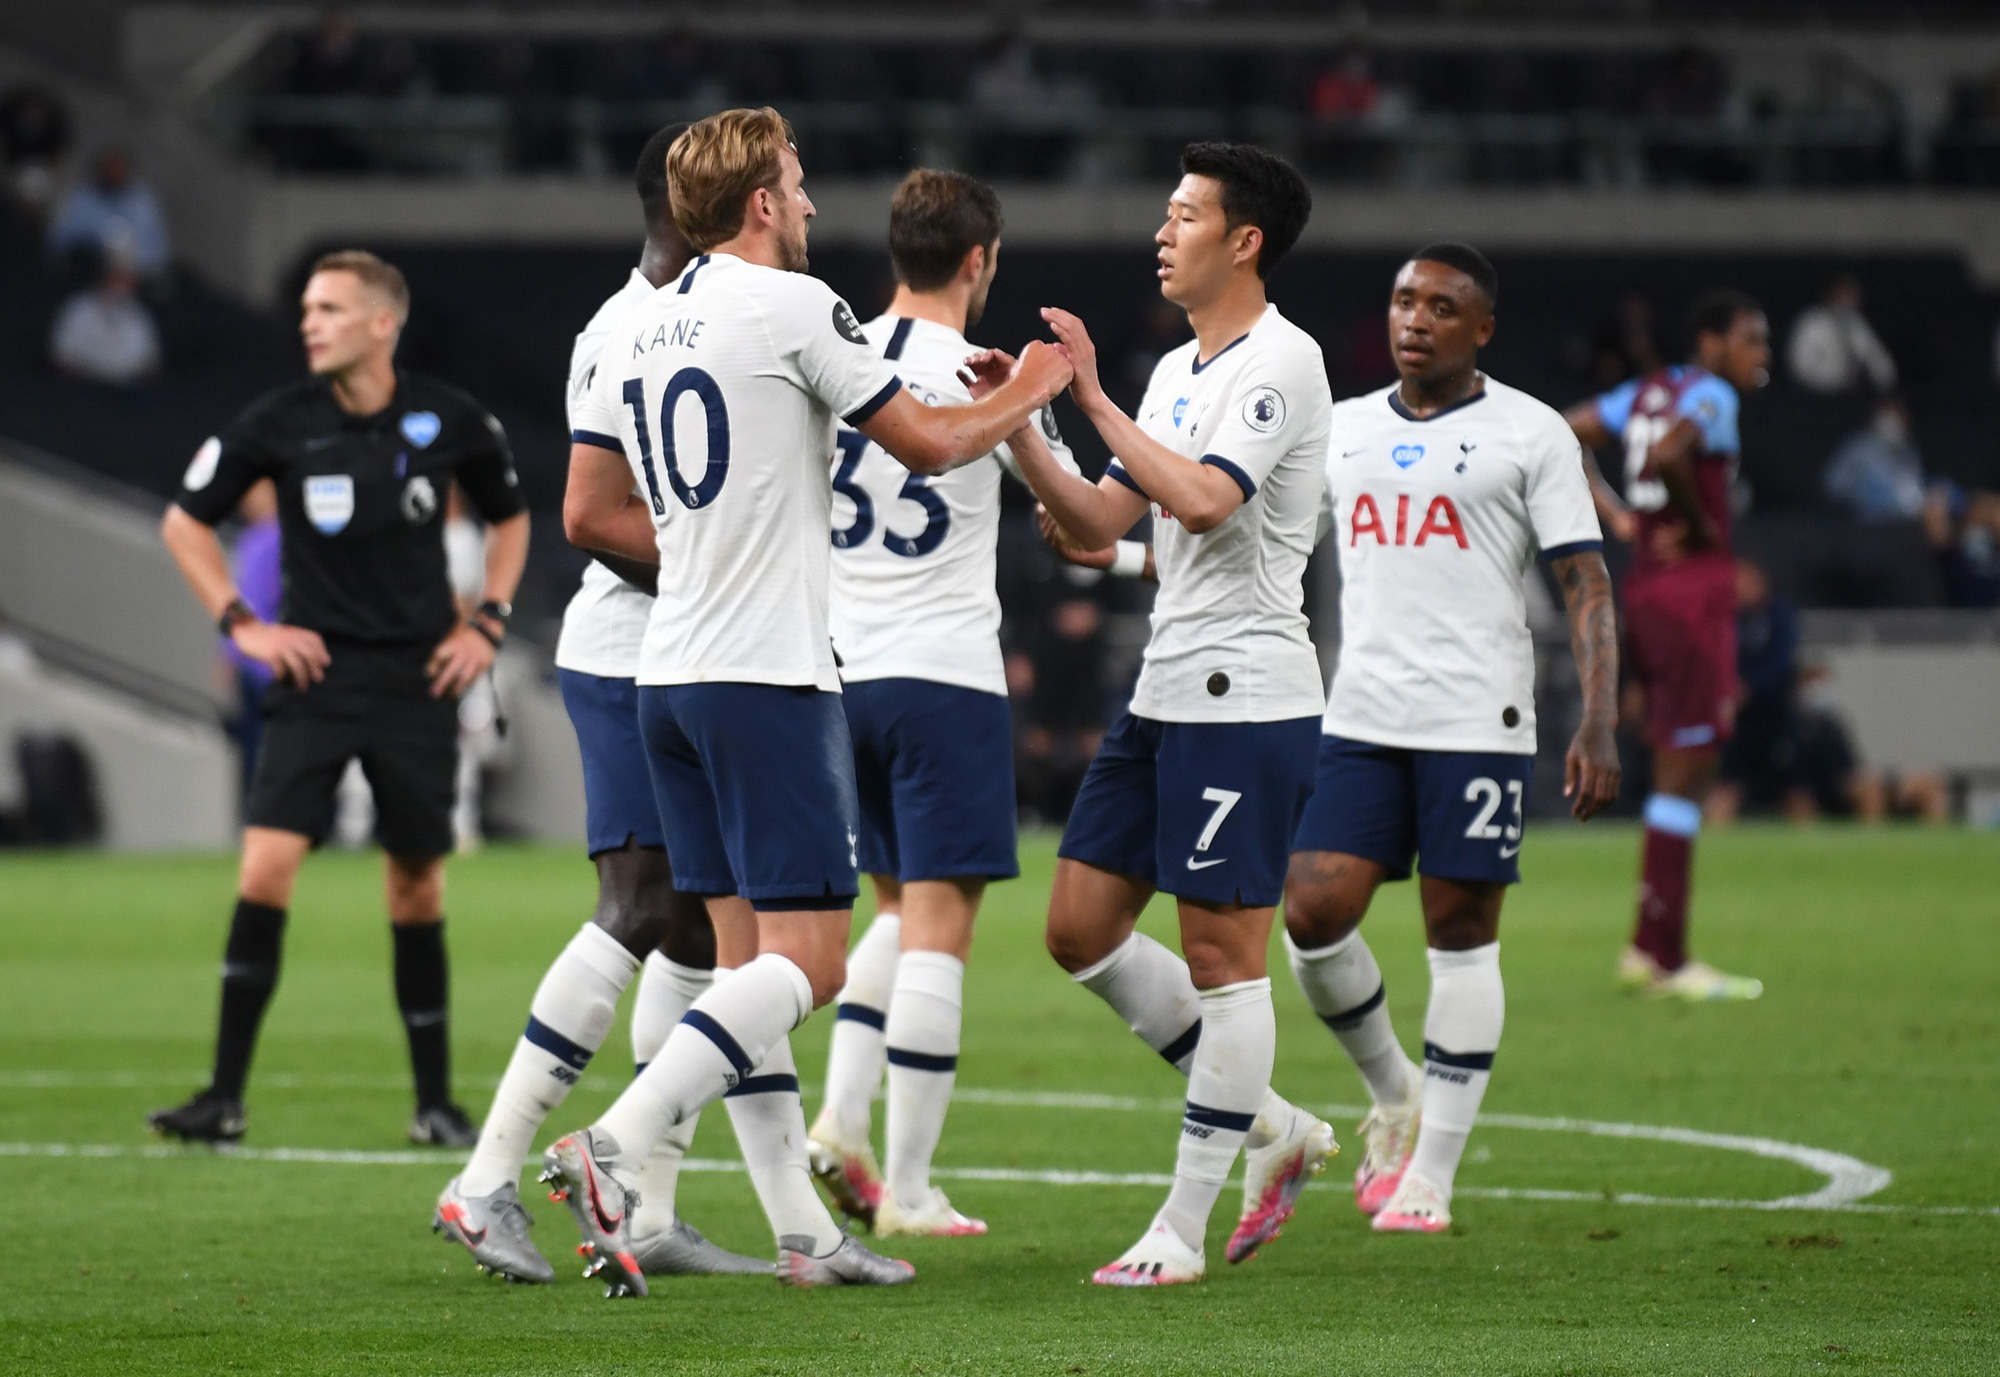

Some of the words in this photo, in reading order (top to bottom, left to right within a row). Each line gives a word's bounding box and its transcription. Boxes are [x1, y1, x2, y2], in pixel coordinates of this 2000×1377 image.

[632, 318, 705, 360] KANE
[622, 366, 730, 517] 10
[831, 428, 951, 558] 33
[1350, 492, 1470, 550] AIA
[1196, 785, 1242, 851] 7
[1463, 776, 1523, 841] 23
